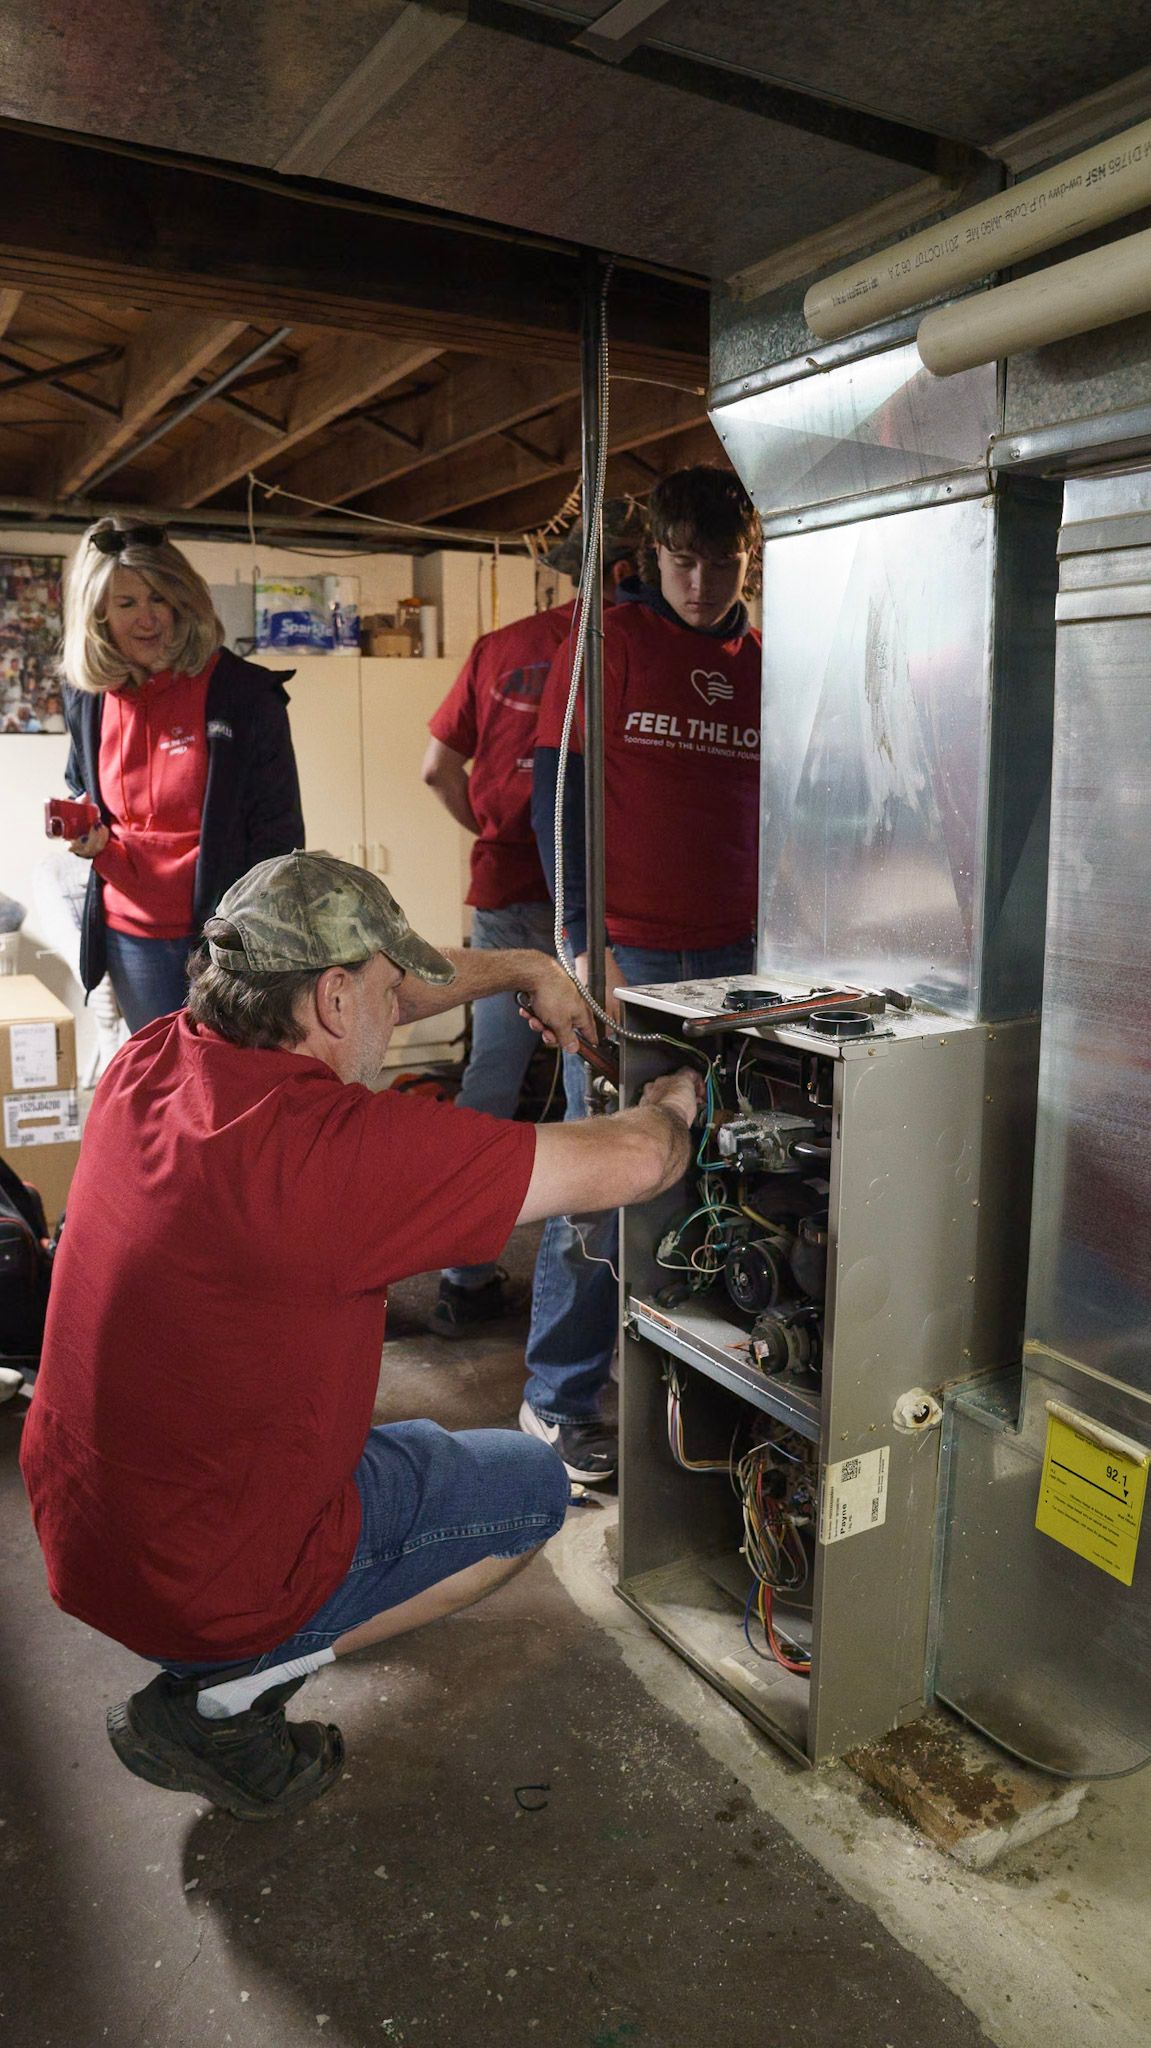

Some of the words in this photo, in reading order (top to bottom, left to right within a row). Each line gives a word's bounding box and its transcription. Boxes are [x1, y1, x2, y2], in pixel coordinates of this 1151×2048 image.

[1085, 163, 1106, 188] NSF
[624, 711, 682, 737] FEEL
[687, 718, 729, 745] THE
[732, 725, 761, 748] LO
[623, 734, 665, 746] Sponsored
[665, 741, 676, 749] by
[678, 741, 694, 750] THE
[707, 747, 736, 757] LENNOX
[1106, 1465, 1128, 1487] 92.1
